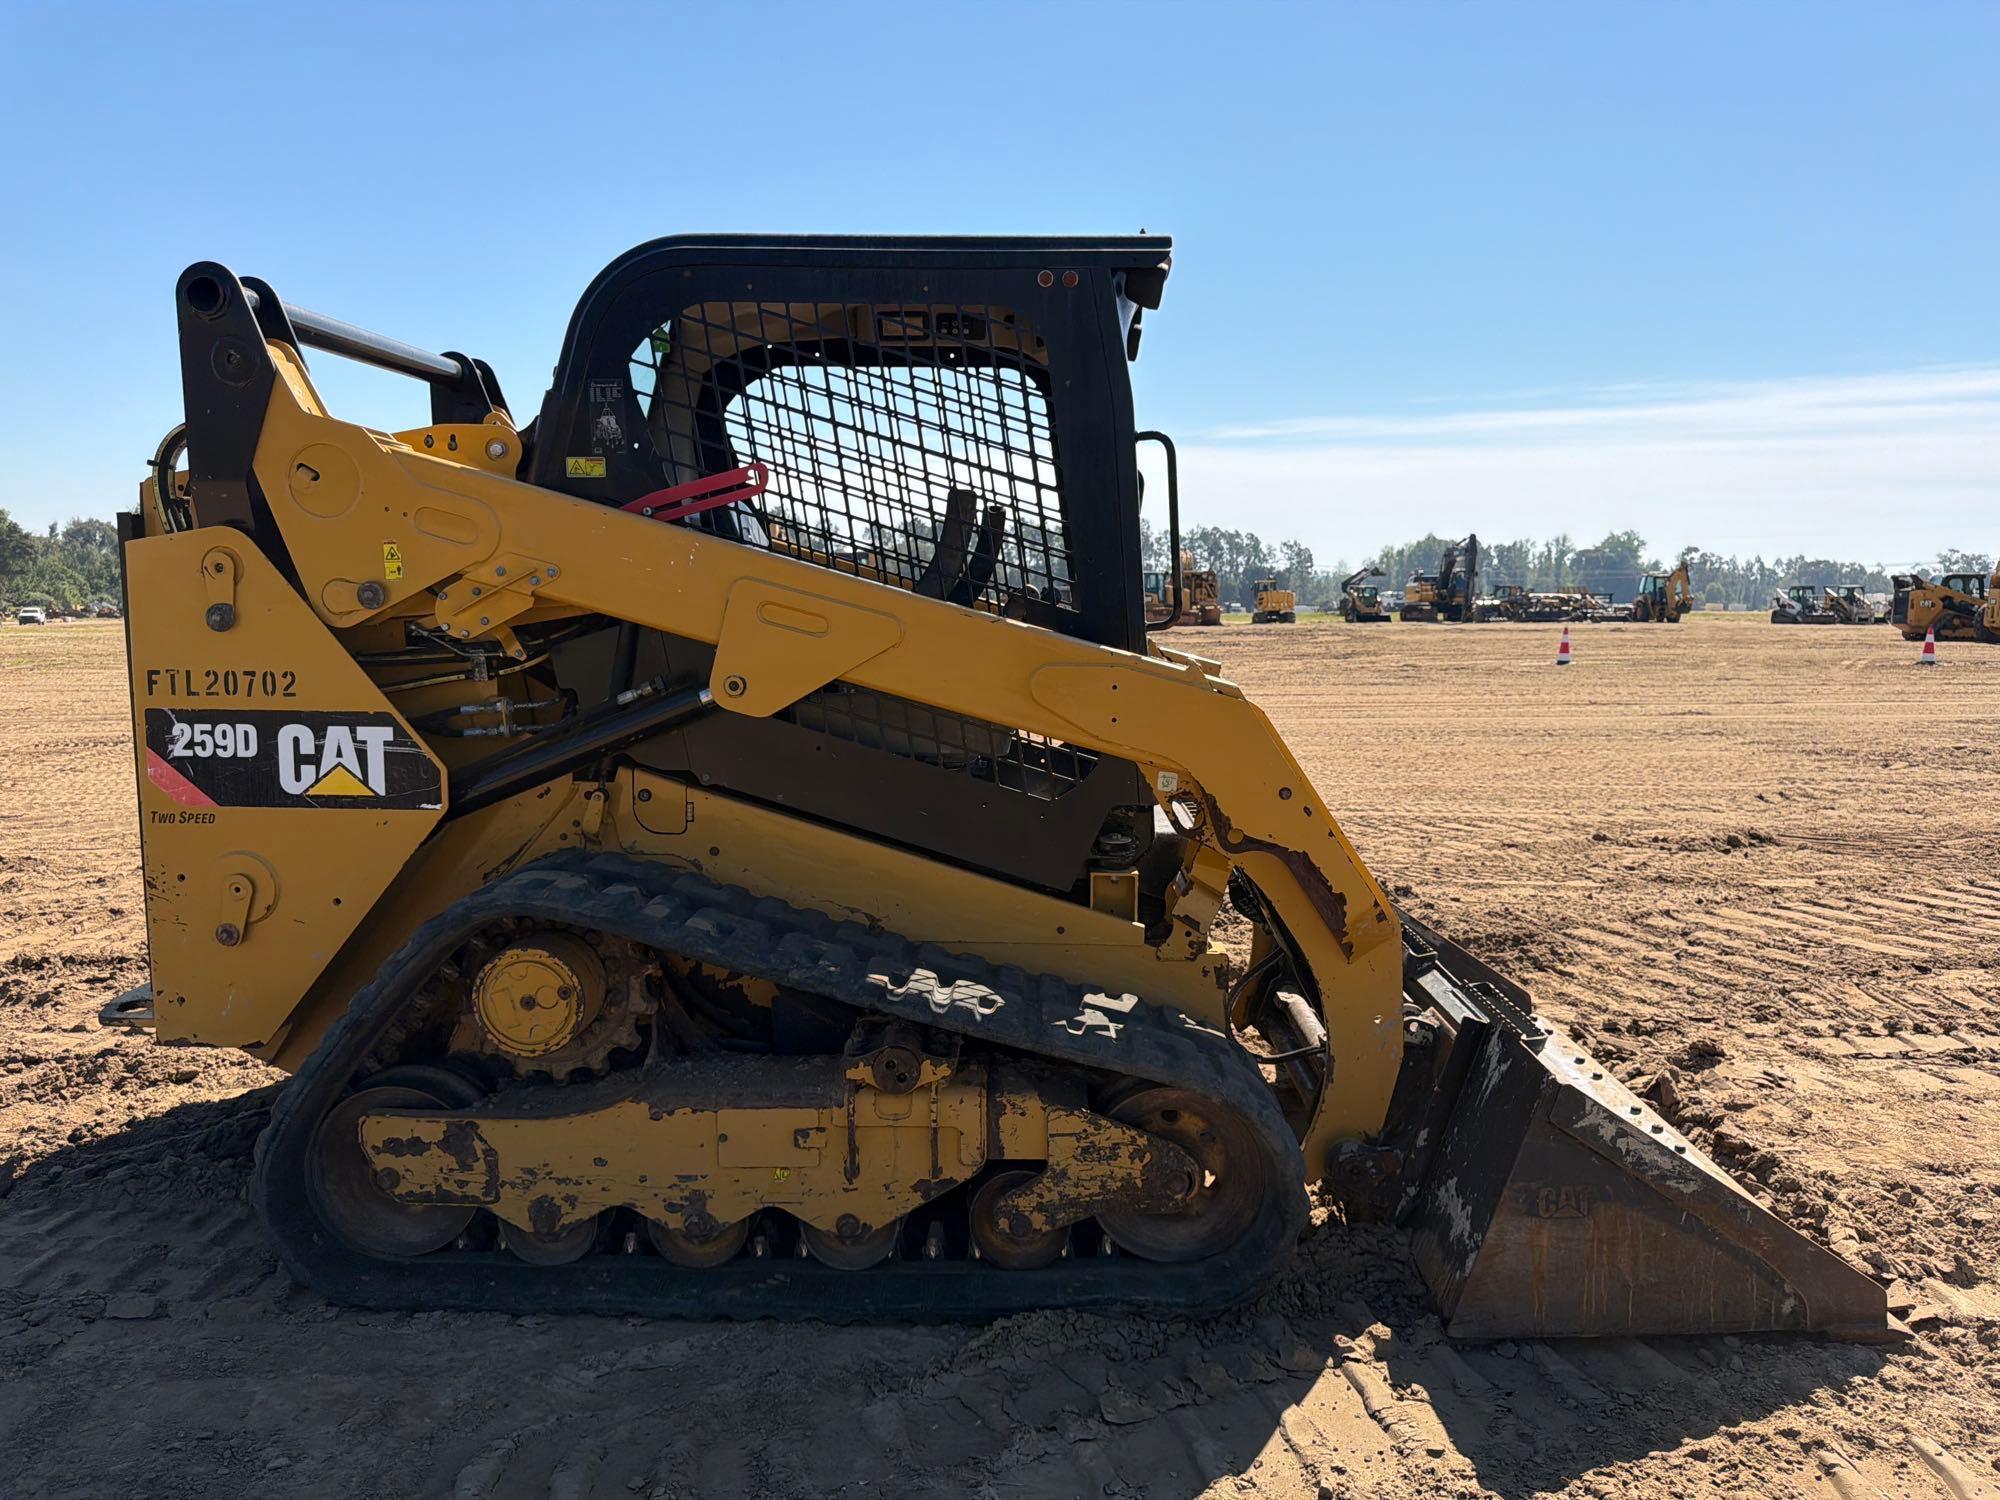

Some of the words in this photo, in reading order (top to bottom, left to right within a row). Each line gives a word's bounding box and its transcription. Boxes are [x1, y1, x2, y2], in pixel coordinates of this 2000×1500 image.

[146, 669, 297, 697] FTL20702
[171, 722, 258, 758] 259D
[277, 723, 394, 797] CAT
[150, 811, 175, 825] TWO
[178, 811, 216, 825] SPEED
[1538, 1186, 1591, 1218] CAT
